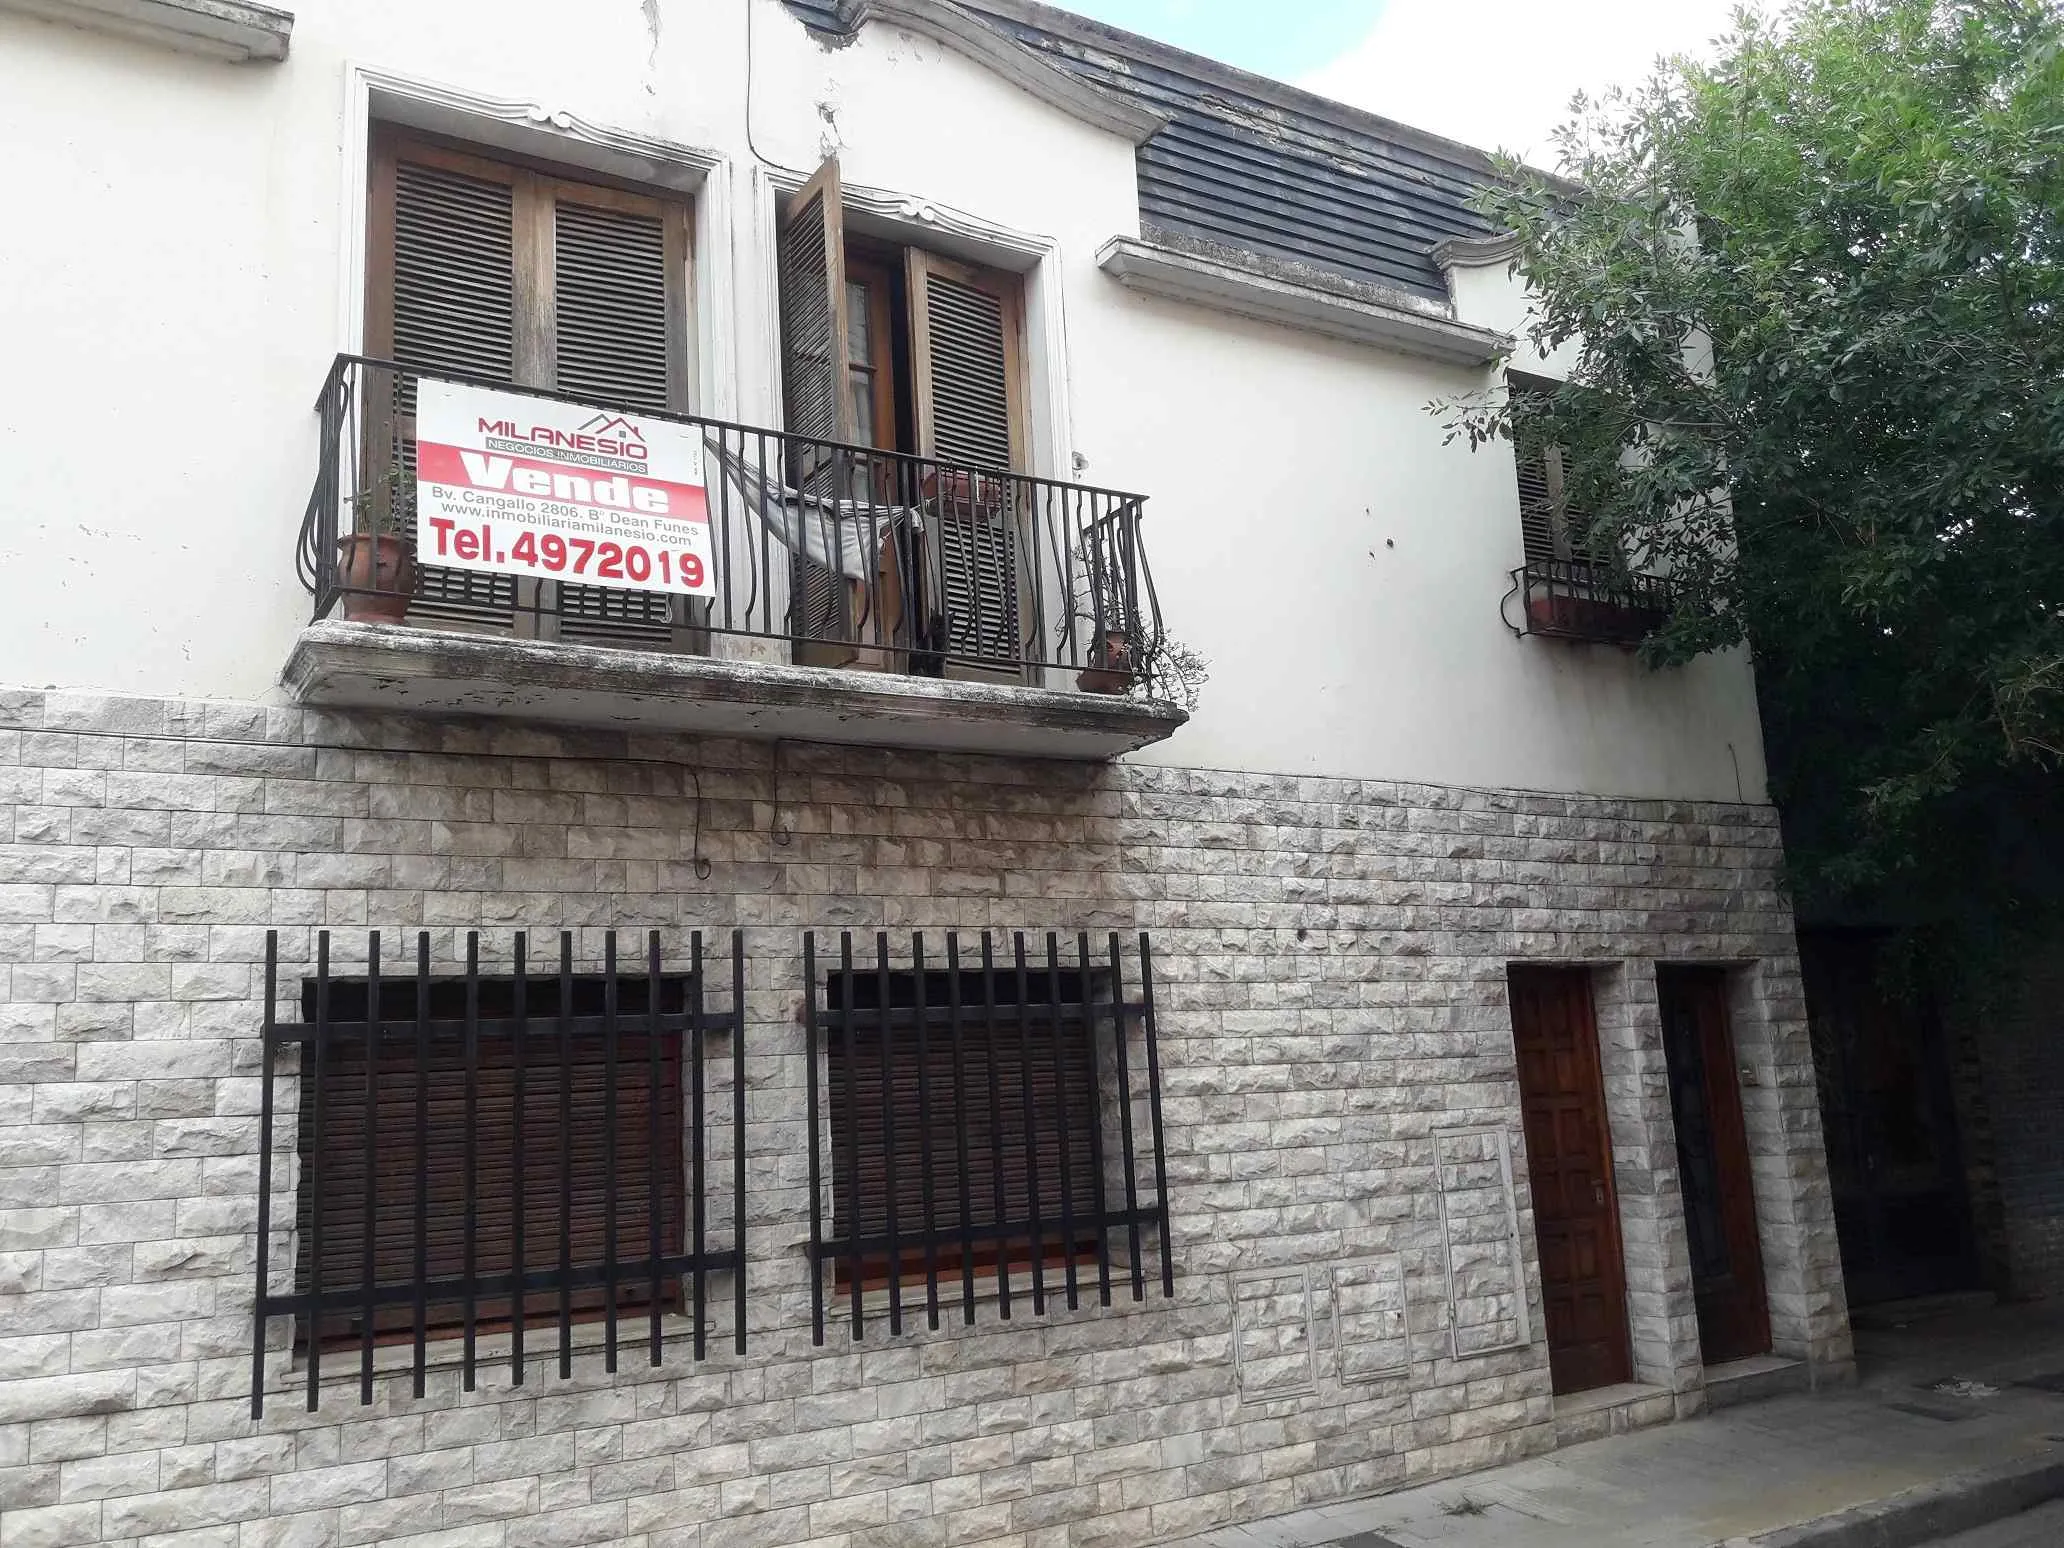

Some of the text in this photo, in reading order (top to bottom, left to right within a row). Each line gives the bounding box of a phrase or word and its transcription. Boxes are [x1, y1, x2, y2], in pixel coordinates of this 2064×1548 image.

[478, 417, 648, 460] MILANESIO
[488, 439, 646, 473] NEGOCIOS INMOBILIARIOS
[459, 450, 669, 513] Vende
[432, 486, 457, 501] Bv.
[463, 490, 536, 512] Cangallo
[540, 502, 583, 519] 2806.
[610, 512, 649, 529] Dean
[654, 519, 699, 536] Funes
[441, 502, 692, 546] www.inmobiliariamilanesio.com
